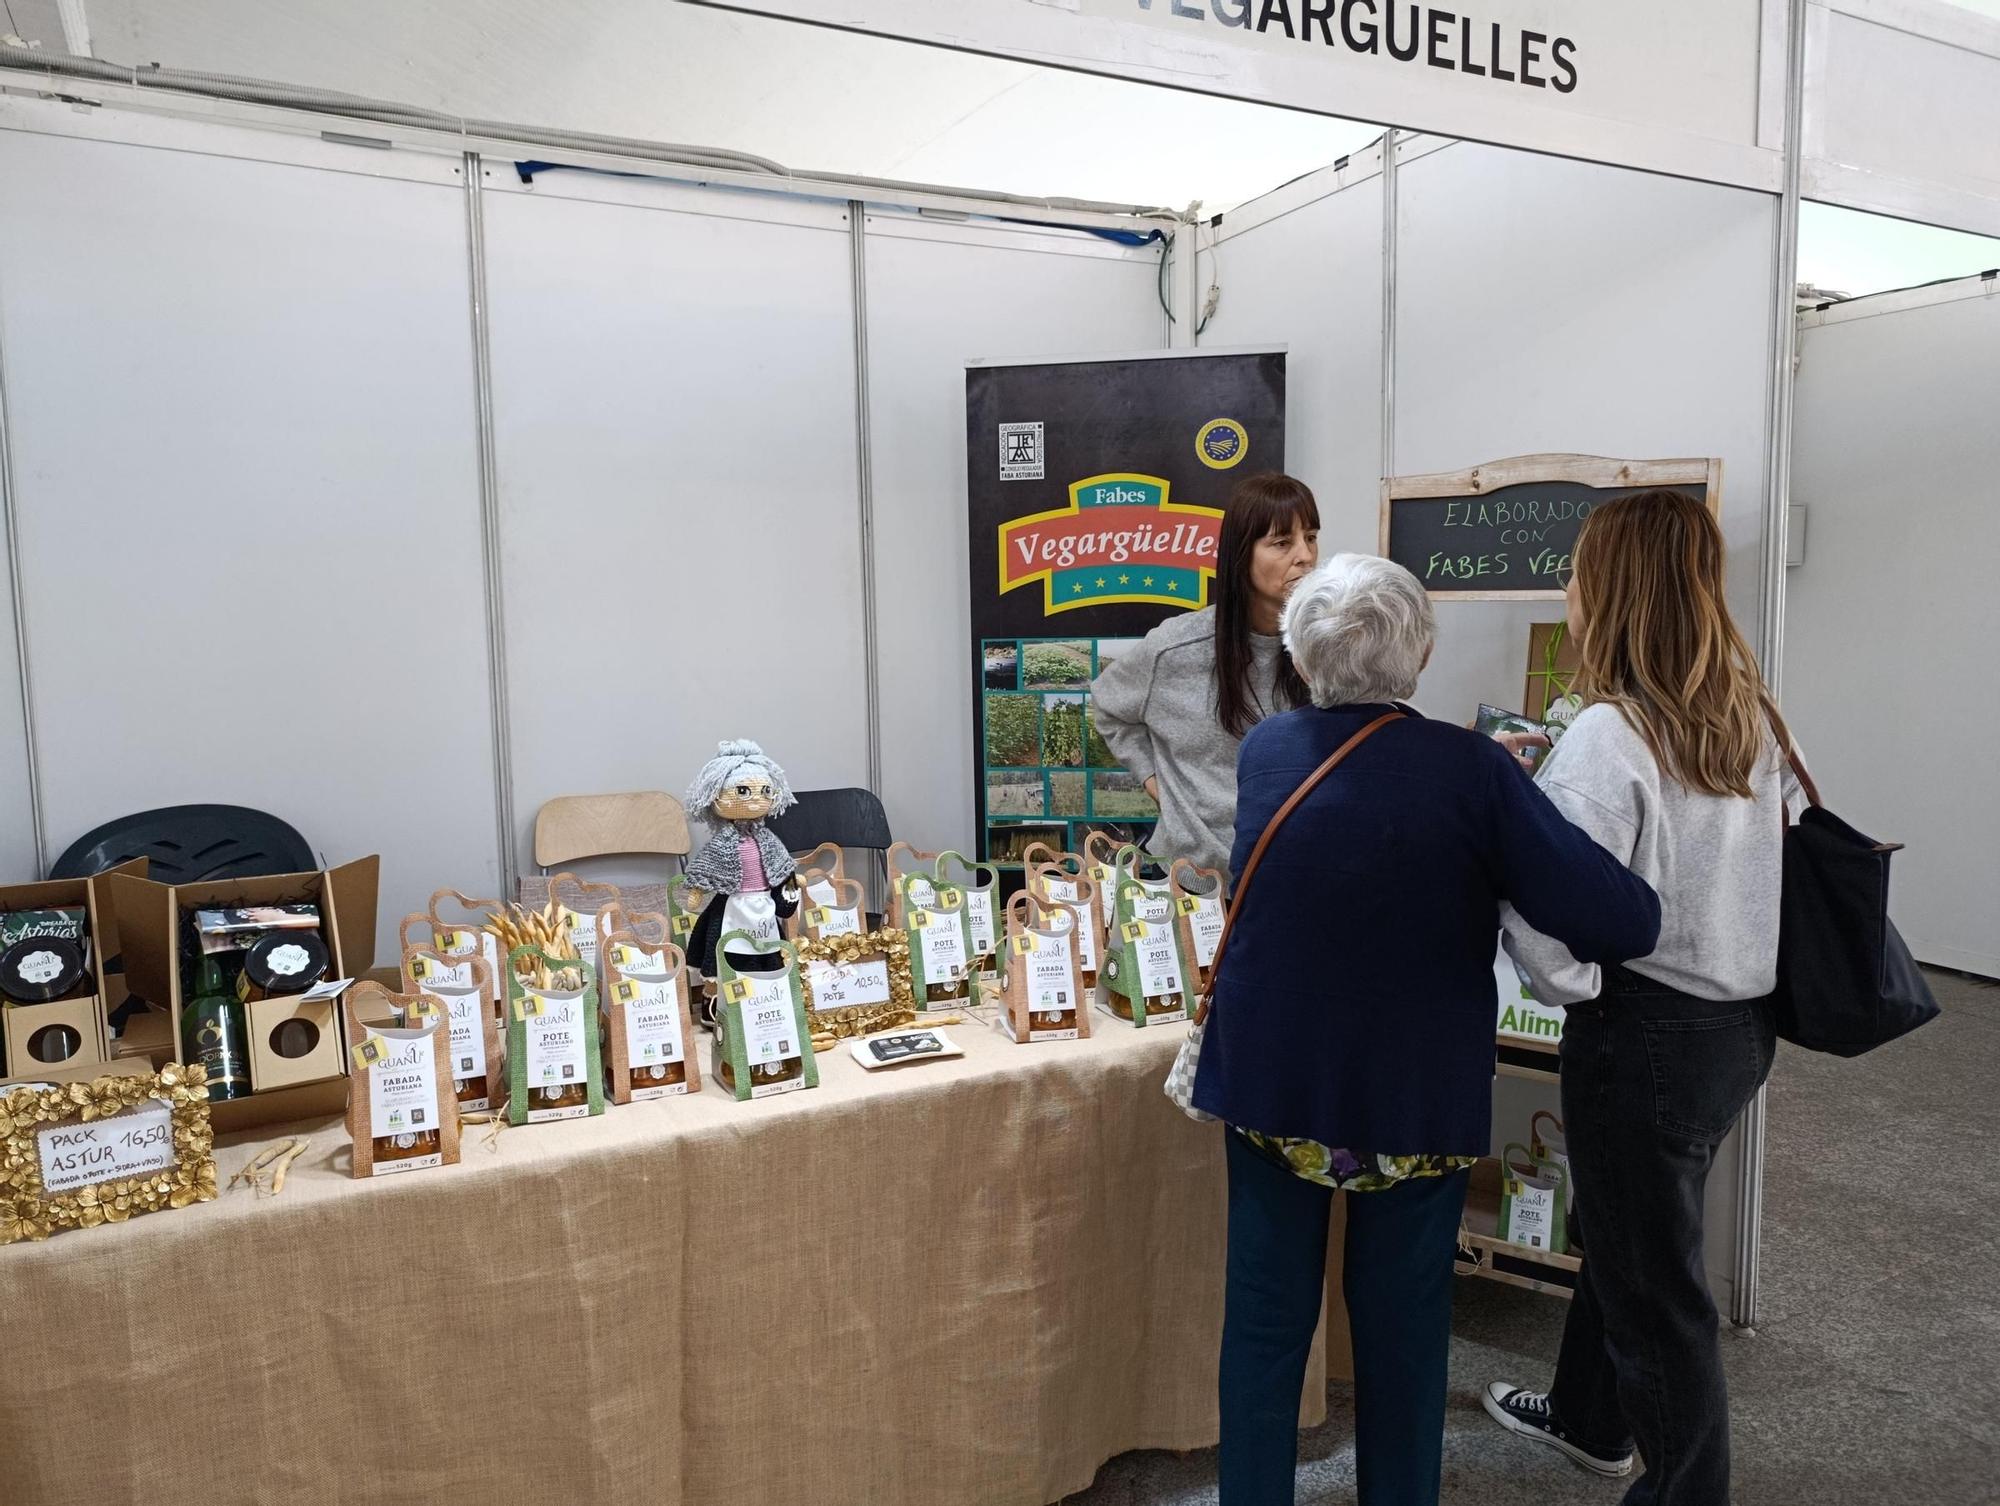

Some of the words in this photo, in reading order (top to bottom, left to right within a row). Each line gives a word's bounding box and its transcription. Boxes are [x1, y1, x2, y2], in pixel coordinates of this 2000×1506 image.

[1138, 0, 1578, 94] ARGUELLES
[1095, 487, 1146, 504] Fabes
[1443, 500, 1592, 528] ELABORADO
[1500, 523, 1555, 545] CON
[1014, 523, 1219, 567] Vegargüelle
[1425, 551, 1509, 580] FABES
[934, 939, 955, 948] POTE
[1150, 949, 1169, 959] POTE
[1036, 965, 1064, 973] FABADA
[823, 990, 846, 1002] POTE
[637, 1013, 670, 1024] FABADA
[757, 1009, 782, 1020] POTE
[1498, 1003, 1560, 1038] Alim
[542, 1031, 571, 1042] POTE
[383, 1075, 422, 1087] FABADA
[383, 1083, 423, 1093] ASTURIANA
[50, 1128, 97, 1150] PACK
[51, 1145, 116, 1172] ASTUR
[1520, 1208, 1541, 1218] POTE
